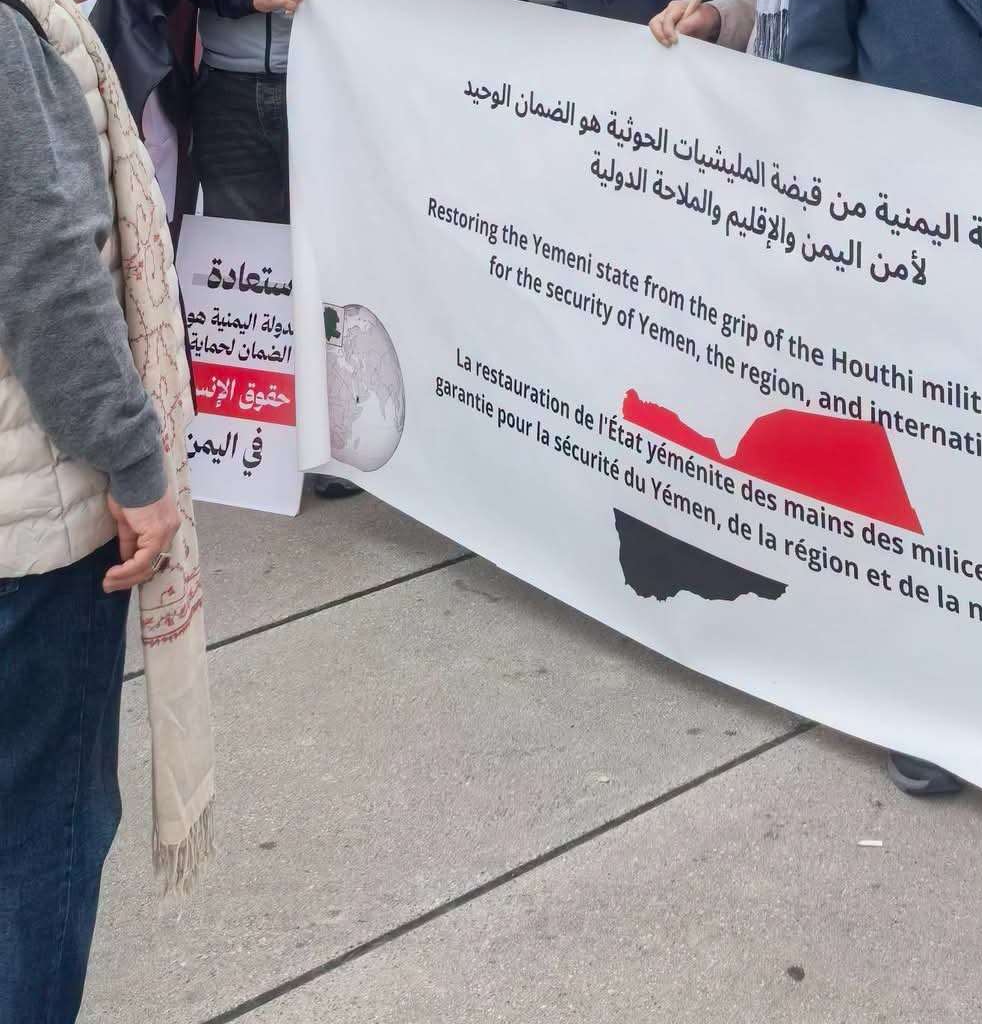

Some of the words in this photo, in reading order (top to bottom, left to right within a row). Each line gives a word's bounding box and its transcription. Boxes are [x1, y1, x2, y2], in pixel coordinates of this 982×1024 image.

[463, 78, 511, 108] الوحيد
[514, 91, 575, 127] الضمان
[579, 116, 601, 136] هو
[607, 111, 668, 154] الحوثية
[590, 151, 648, 193] الدولية
[770, 162, 822, 212] قبضة
[652, 169, 721, 225] والملاحة
[829, 192, 867, 221] من
[725, 205, 796, 254] والإقليم
[875, 192, 959, 247] اليمنية
[801, 233, 862, 273] اليمن
[870, 249, 927, 286] لأمن
[207, 258, 293, 296] ستعادة
[428, 197, 498, 245] Restoring
[502, 225, 528, 251] the
[533, 234, 592, 275] Yemeni
[596, 262, 639, 293] state
[644, 276, 684, 311] from
[690, 296, 717, 325] the
[722, 313, 758, 346] grip
[764, 328, 784, 351] of
[789, 336, 824, 366] the
[832, 348, 913, 394] Houthi
[187, 311, 206, 328] هو
[211, 307, 257, 335] اليمنية
[489, 256, 512, 281] for
[516, 267, 542, 293] the
[546, 280, 612, 325] security
[617, 309, 635, 328] of
[639, 312, 700, 362] Yemen,
[706, 343, 735, 374] the
[741, 359, 811, 406] region,
[819, 390, 862, 419] and
[190, 332, 235, 356] لحماية
[238, 341, 292, 363] الضمان
[195, 376, 236, 408] الإنس
[239, 383, 290, 411] حقوق
[243, 427, 262, 477] في
[457, 348, 471, 372] La
[476, 359, 570, 419] restauration
[575, 405, 594, 430] de
[600, 413, 642, 453] l'État
[648, 439, 735, 494] yéménite
[741, 480, 777, 511] des
[785, 499, 854, 538] mains
[862, 522, 904, 555] des
[436, 376, 493, 418] garantie
[498, 406, 533, 437] pour
[537, 422, 550, 446] la
[554, 435, 619, 480] sécurité
[624, 468, 646, 494] du
[651, 477, 721, 531] Yémen,
[728, 513, 752, 540] de
[759, 523, 776, 551] la
[785, 538, 858, 580] région
[867, 569, 891, 591] et
[899, 576, 929, 603] de
[938, 585, 959, 614] la
